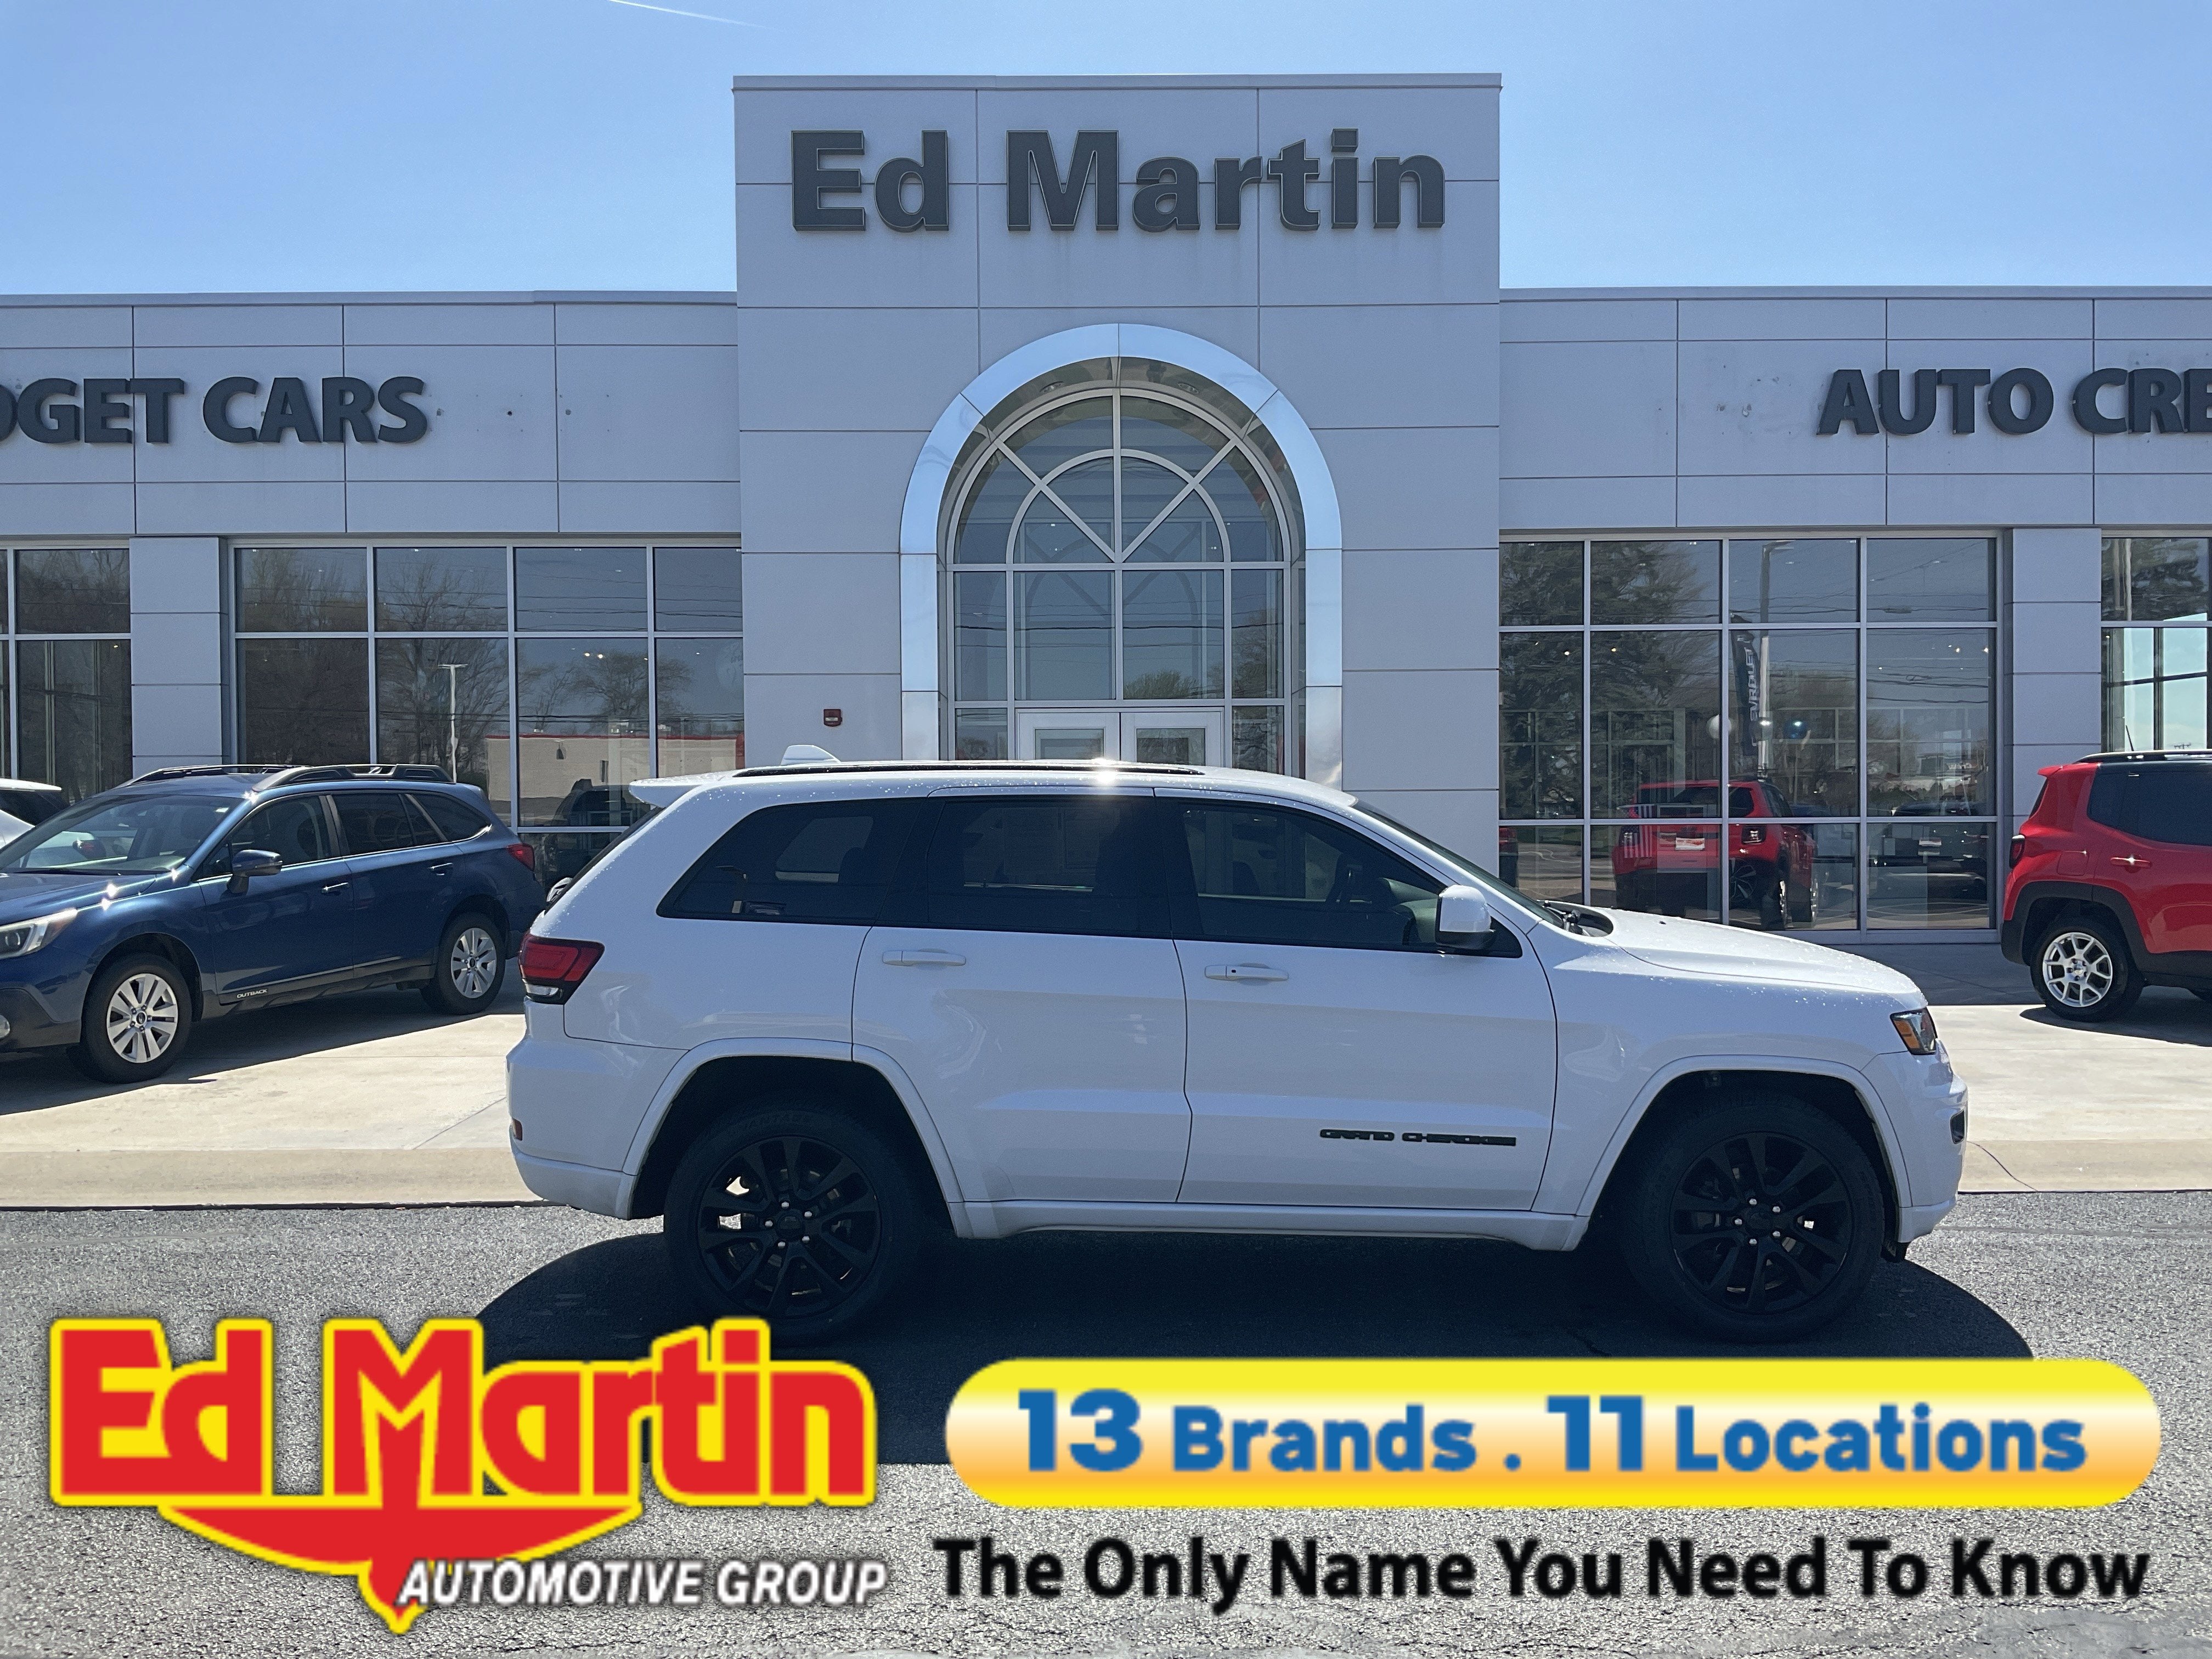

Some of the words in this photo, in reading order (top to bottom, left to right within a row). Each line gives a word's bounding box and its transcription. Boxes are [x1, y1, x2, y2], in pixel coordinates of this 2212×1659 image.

[791, 129, 949, 232] Ed
[1006, 128, 1446, 232] Martin
[203, 376, 428, 444] CARS
[1816, 368, 2054, 436] AUTO
[1743, 646, 1758, 747] CEVROLET
[236, 989, 267, 998] OUTBACK
[1319, 1129, 1395, 1141] GRAND
[1402, 1132, 1516, 1147] CHROK
